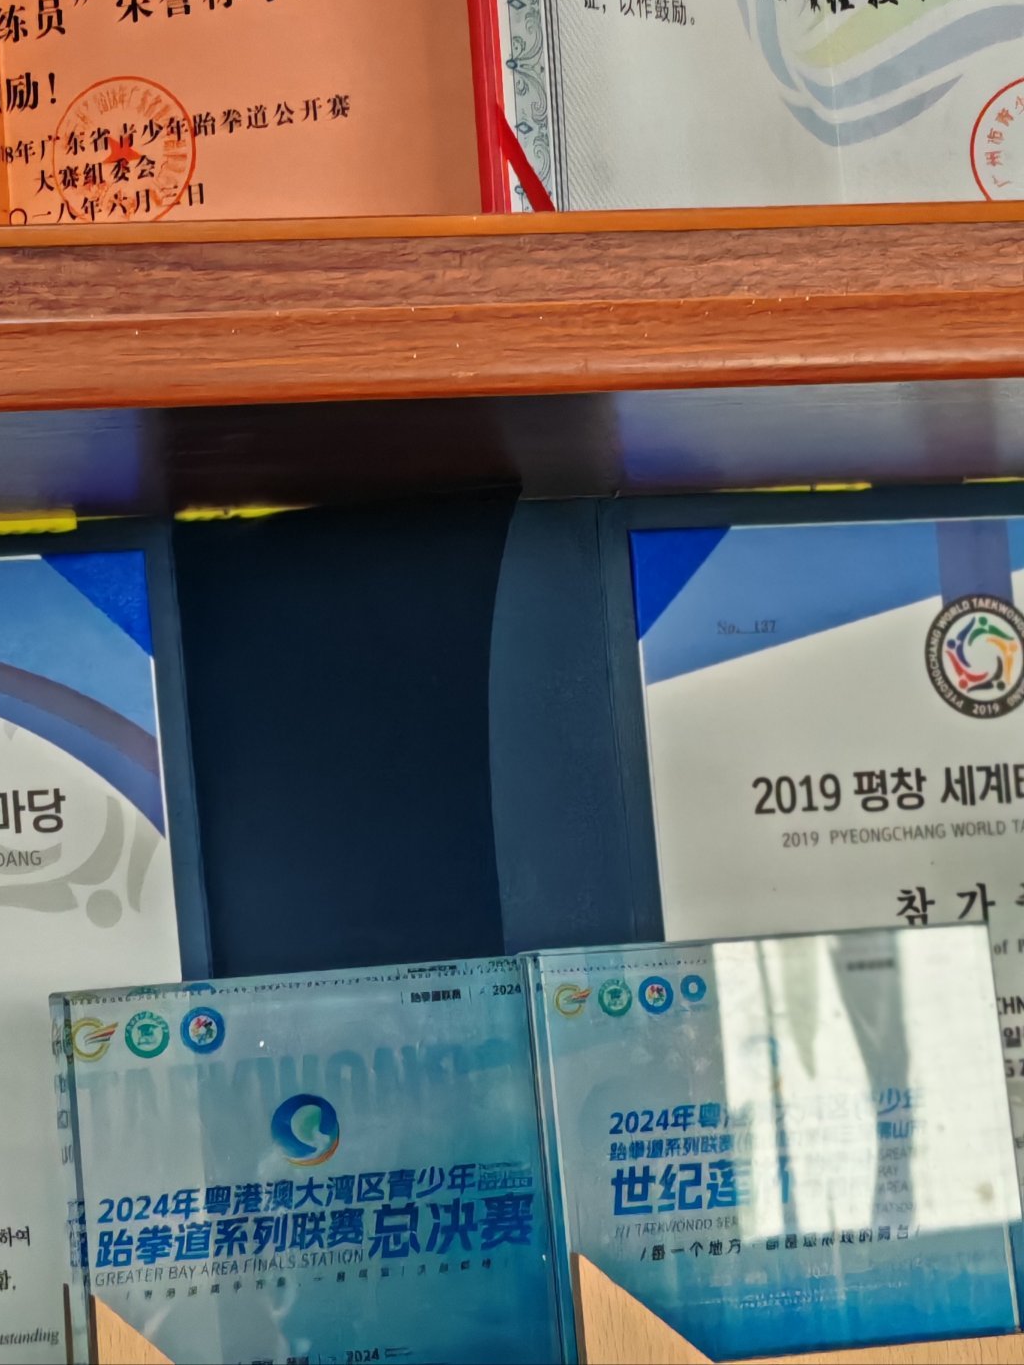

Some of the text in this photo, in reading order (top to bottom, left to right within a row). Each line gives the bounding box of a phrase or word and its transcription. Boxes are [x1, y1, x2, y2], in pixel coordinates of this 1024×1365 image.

[34, 155, 157, 195] 大赛组委会
[937, 599, 971, 631] WORLD
[972, 703, 1001, 715] 2019
[751, 772, 842, 815] 2019
[853, 766, 927, 813] 평창
[781, 831, 820, 849] 2019
[828, 822, 947, 846] PYEONGCHANG
[951, 819, 1007, 838] WORLD
[993, 940, 1008, 955] of
[96, 1163, 477, 1224] 2024年粤港澳大湾区青少年
[94, 1191, 535, 1269] 跆拳道系列联赛总决赛
[94, 1247, 365, 1287] GREATER BAY AREA FINALS STATION
